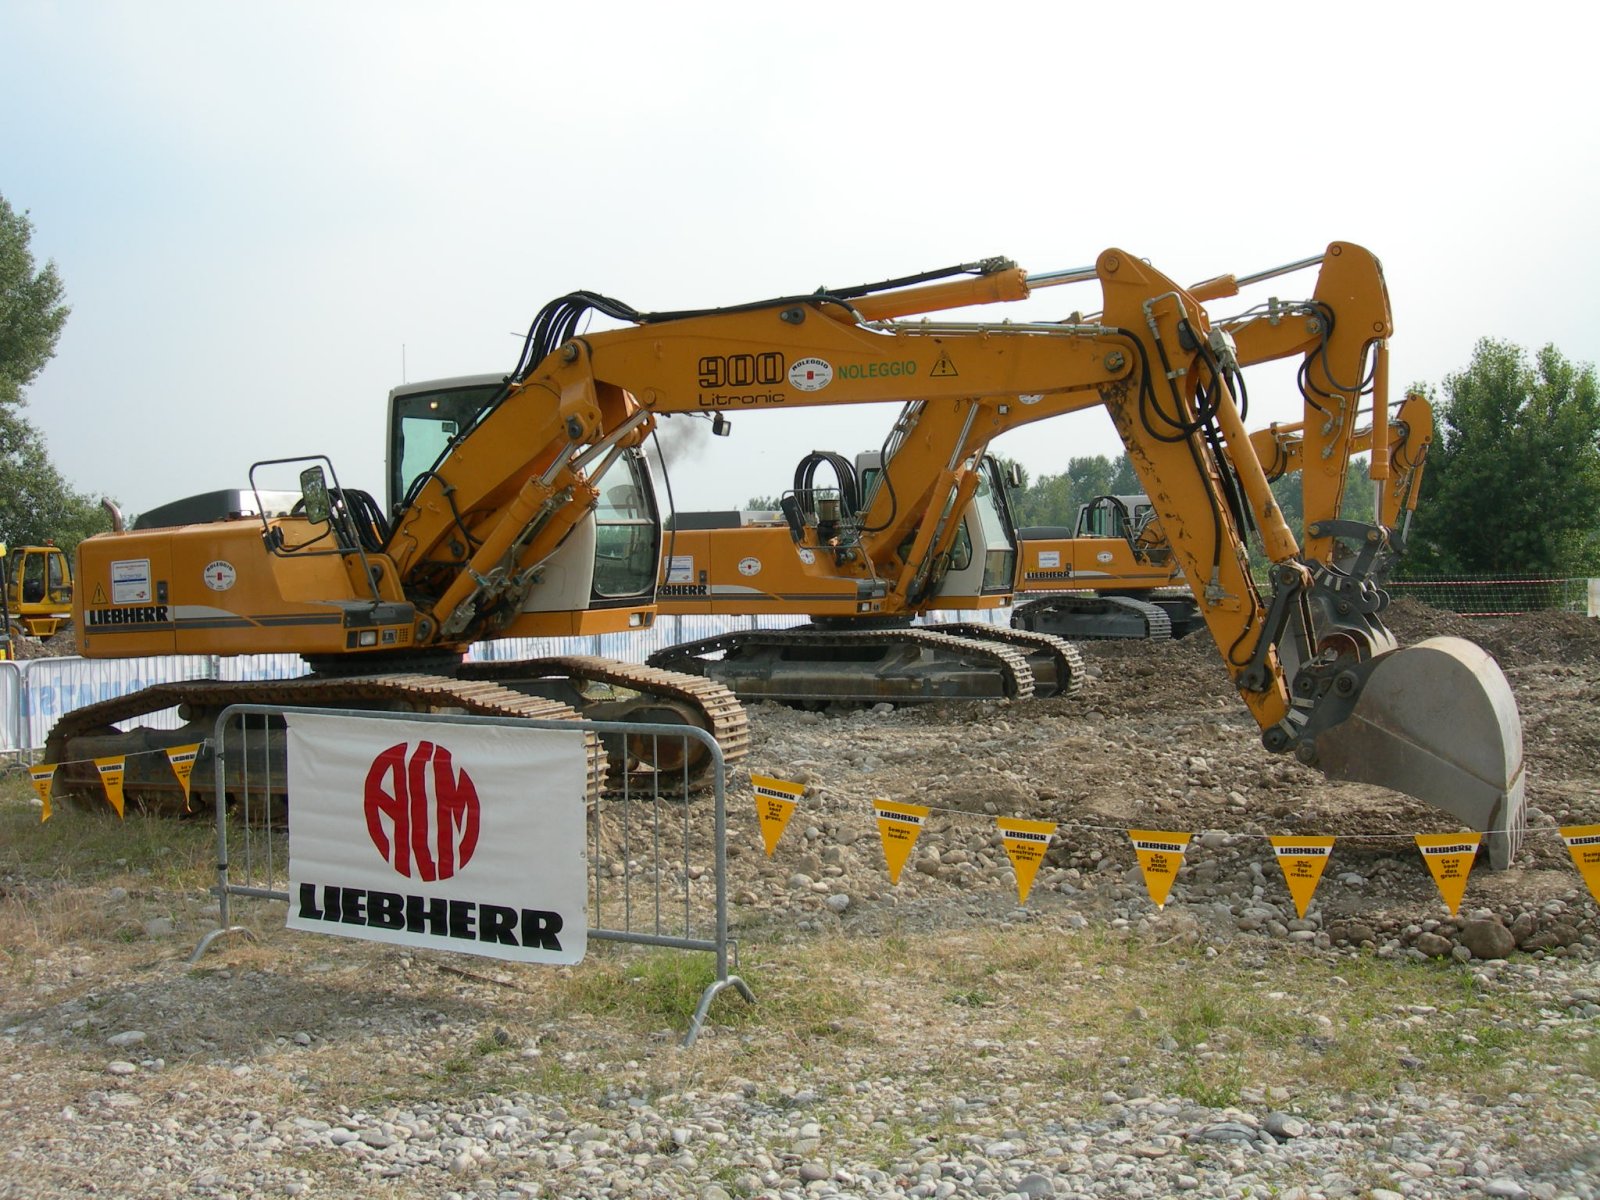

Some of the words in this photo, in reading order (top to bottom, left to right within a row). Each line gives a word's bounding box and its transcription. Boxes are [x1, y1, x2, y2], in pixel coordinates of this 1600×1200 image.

[698, 352, 784, 388] 900
[792, 359, 828, 371] NOLEGGIO
[837, 360, 917, 379] NOLEGGIO
[698, 390, 785, 406] Litronic
[1027, 571, 1070, 579] LIEBHERR
[89, 605, 168, 625] LIEBHERR
[1280, 847, 1326, 855] LIEBHERR
[298, 883, 563, 951] LIEBHERR
